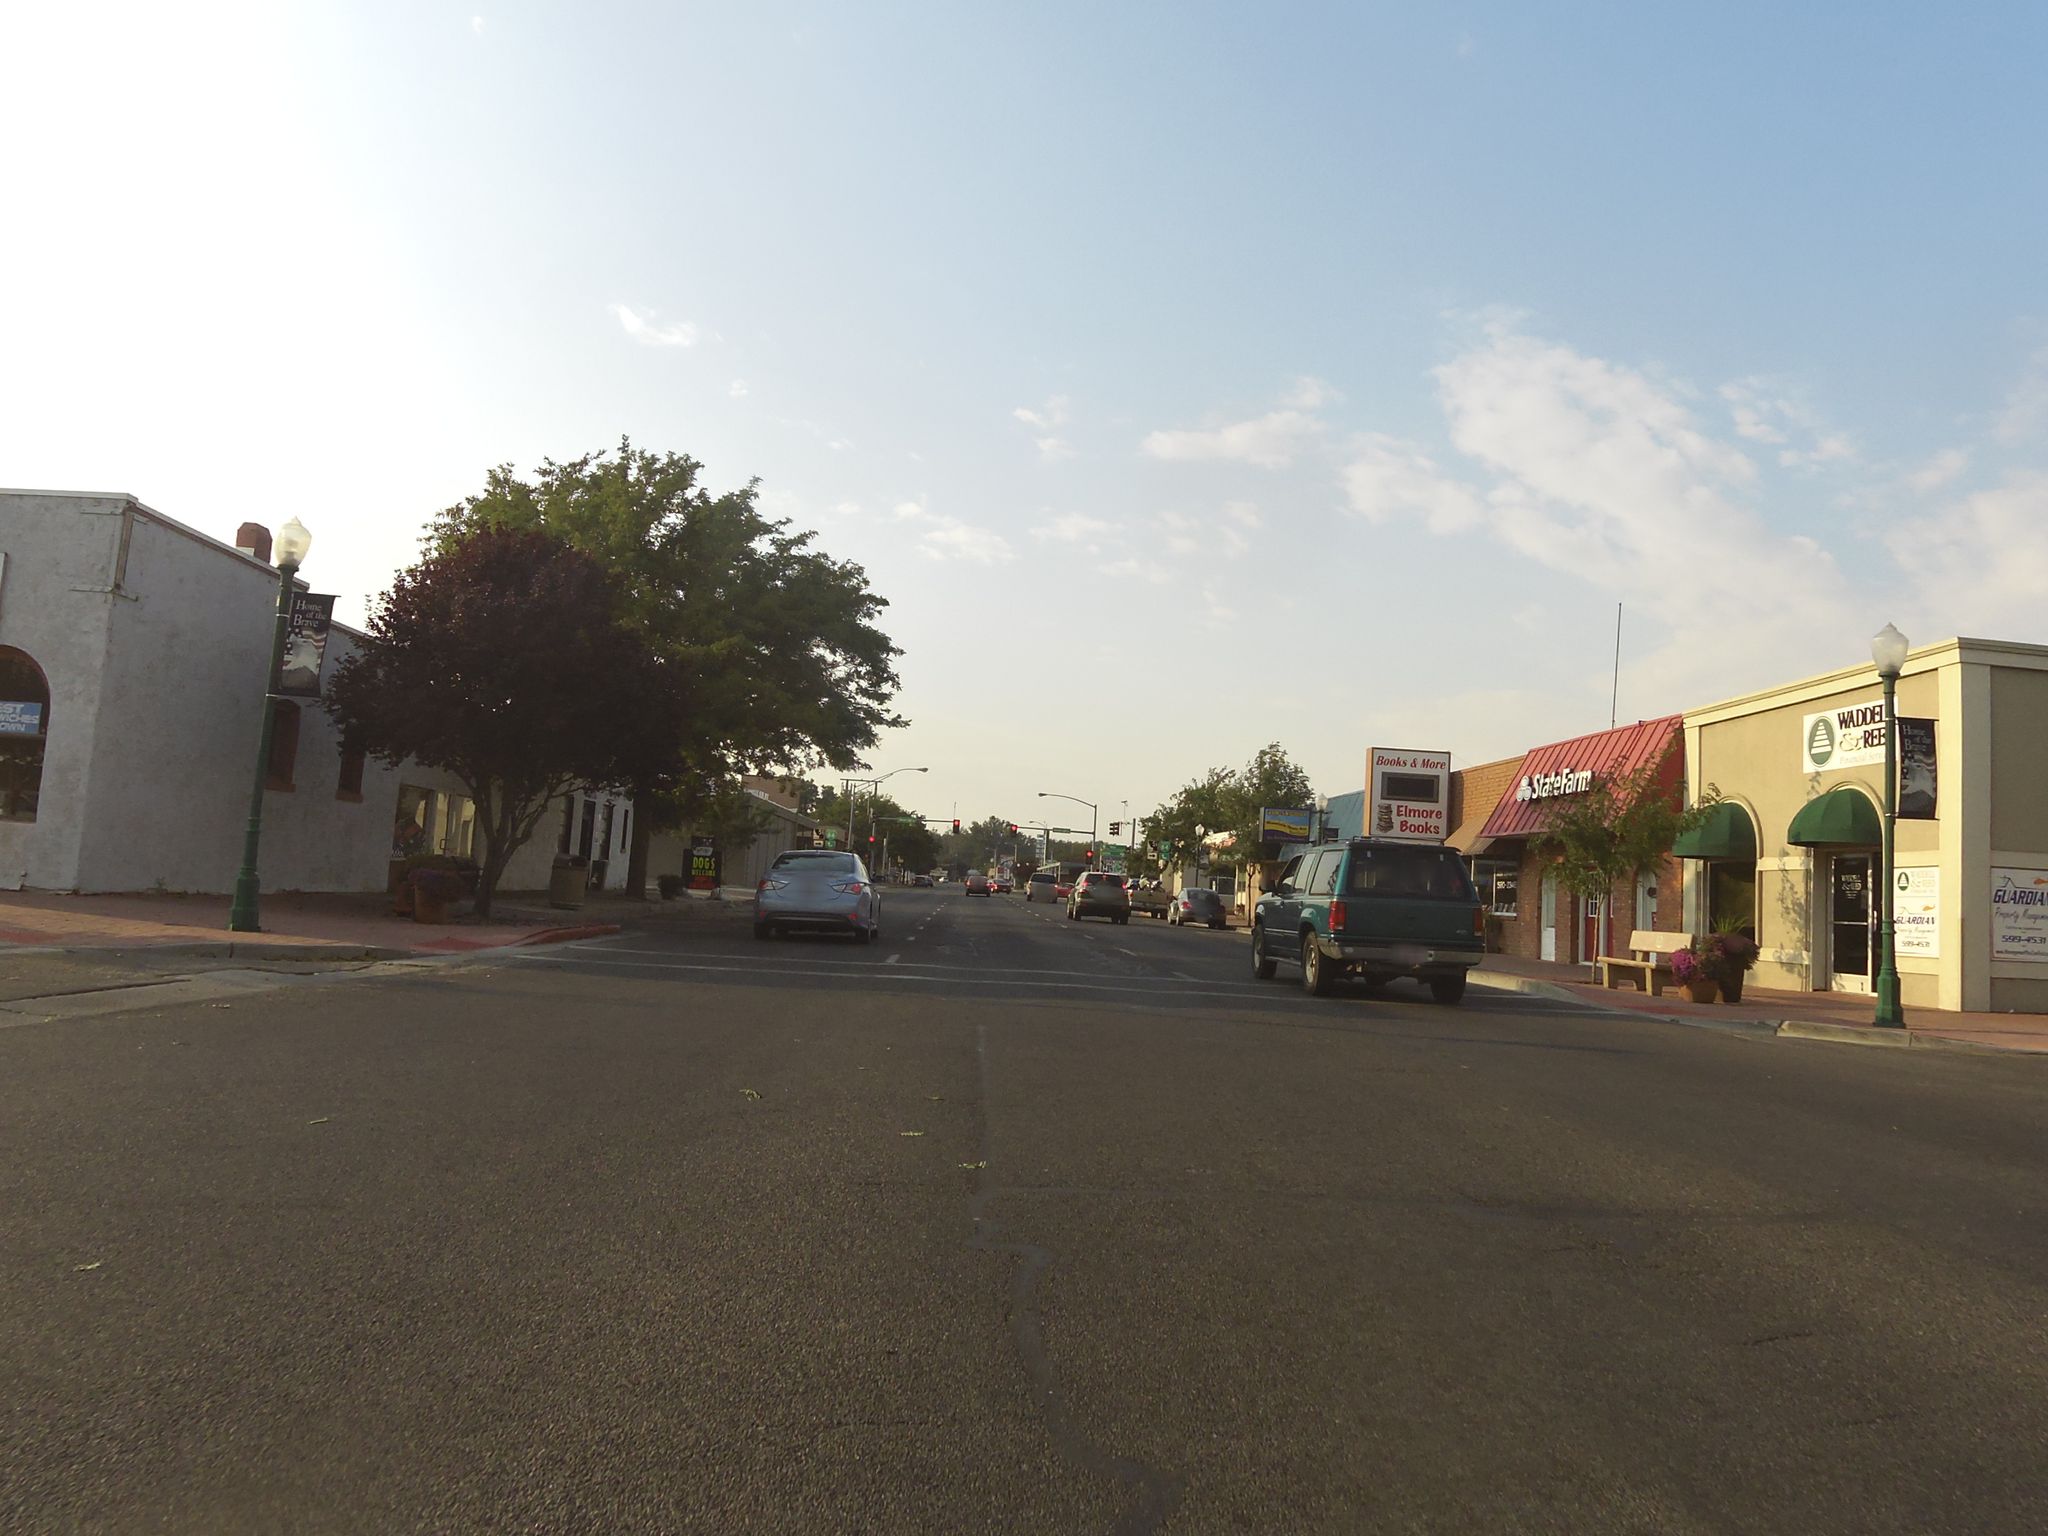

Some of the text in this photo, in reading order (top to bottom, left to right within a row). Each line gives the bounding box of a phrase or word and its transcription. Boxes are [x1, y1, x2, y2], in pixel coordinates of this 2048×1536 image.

[296, 600, 322, 611] Home
[294, 614, 319, 628] Brave
[1838, 704, 1885, 731] WADDEL
[1839, 727, 1886, 752] & REE
[1376, 755, 1446, 770] Books & More
[1396, 804, 1443, 819] Elmore
[1399, 820, 1440, 835] Books
[692, 856, 716, 870] DOGS
[1896, 916, 1935, 925] GUARDIAN
[2001, 934, 2047, 945] 599-4531
